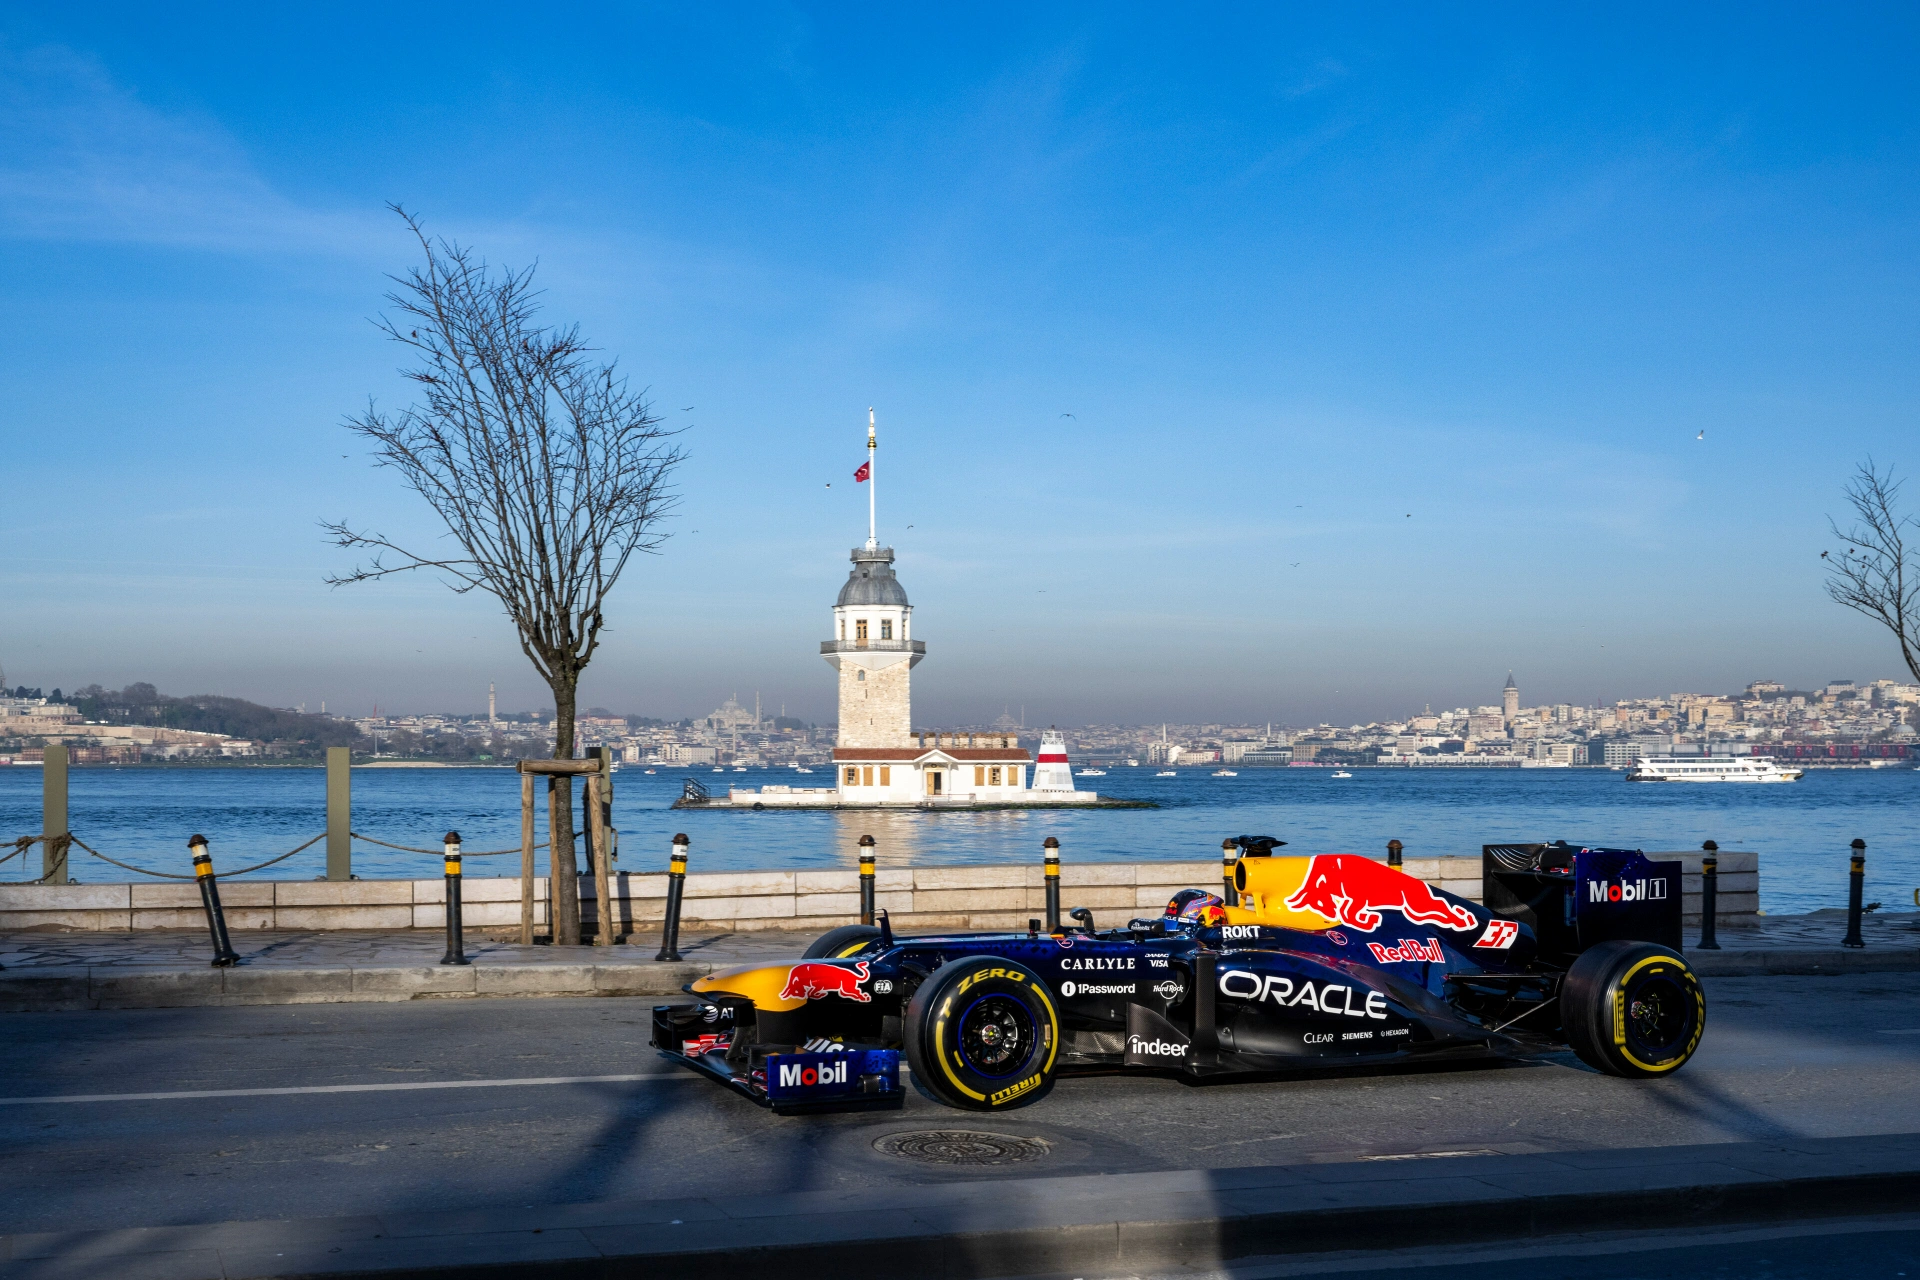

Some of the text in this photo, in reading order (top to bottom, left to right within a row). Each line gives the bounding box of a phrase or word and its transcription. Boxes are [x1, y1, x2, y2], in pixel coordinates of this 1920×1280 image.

[1589, 879, 1646, 902] Mobil
[1222, 926, 1261, 938] ROKT
[1478, 922, 1517, 948] 37
[1061, 958, 1136, 970] CARLYLE
[1149, 960, 1169, 968] VISA
[956, 968, 1026, 995] ZERO
[1078, 984, 1136, 994] 1Password
[1153, 984, 1184, 994] Hard Rock
[1219, 970, 1388, 1020] ORACLE
[1613, 990, 1626, 1044] PIRELLI
[1304, 1033, 1334, 1044] CLEAR
[1341, 1031, 1373, 1040] SIEMENS
[1385, 1028, 1409, 1037] HEXAGON
[780, 1061, 847, 1088] Mobil
[991, 1072, 1042, 1106] PIRELLI
